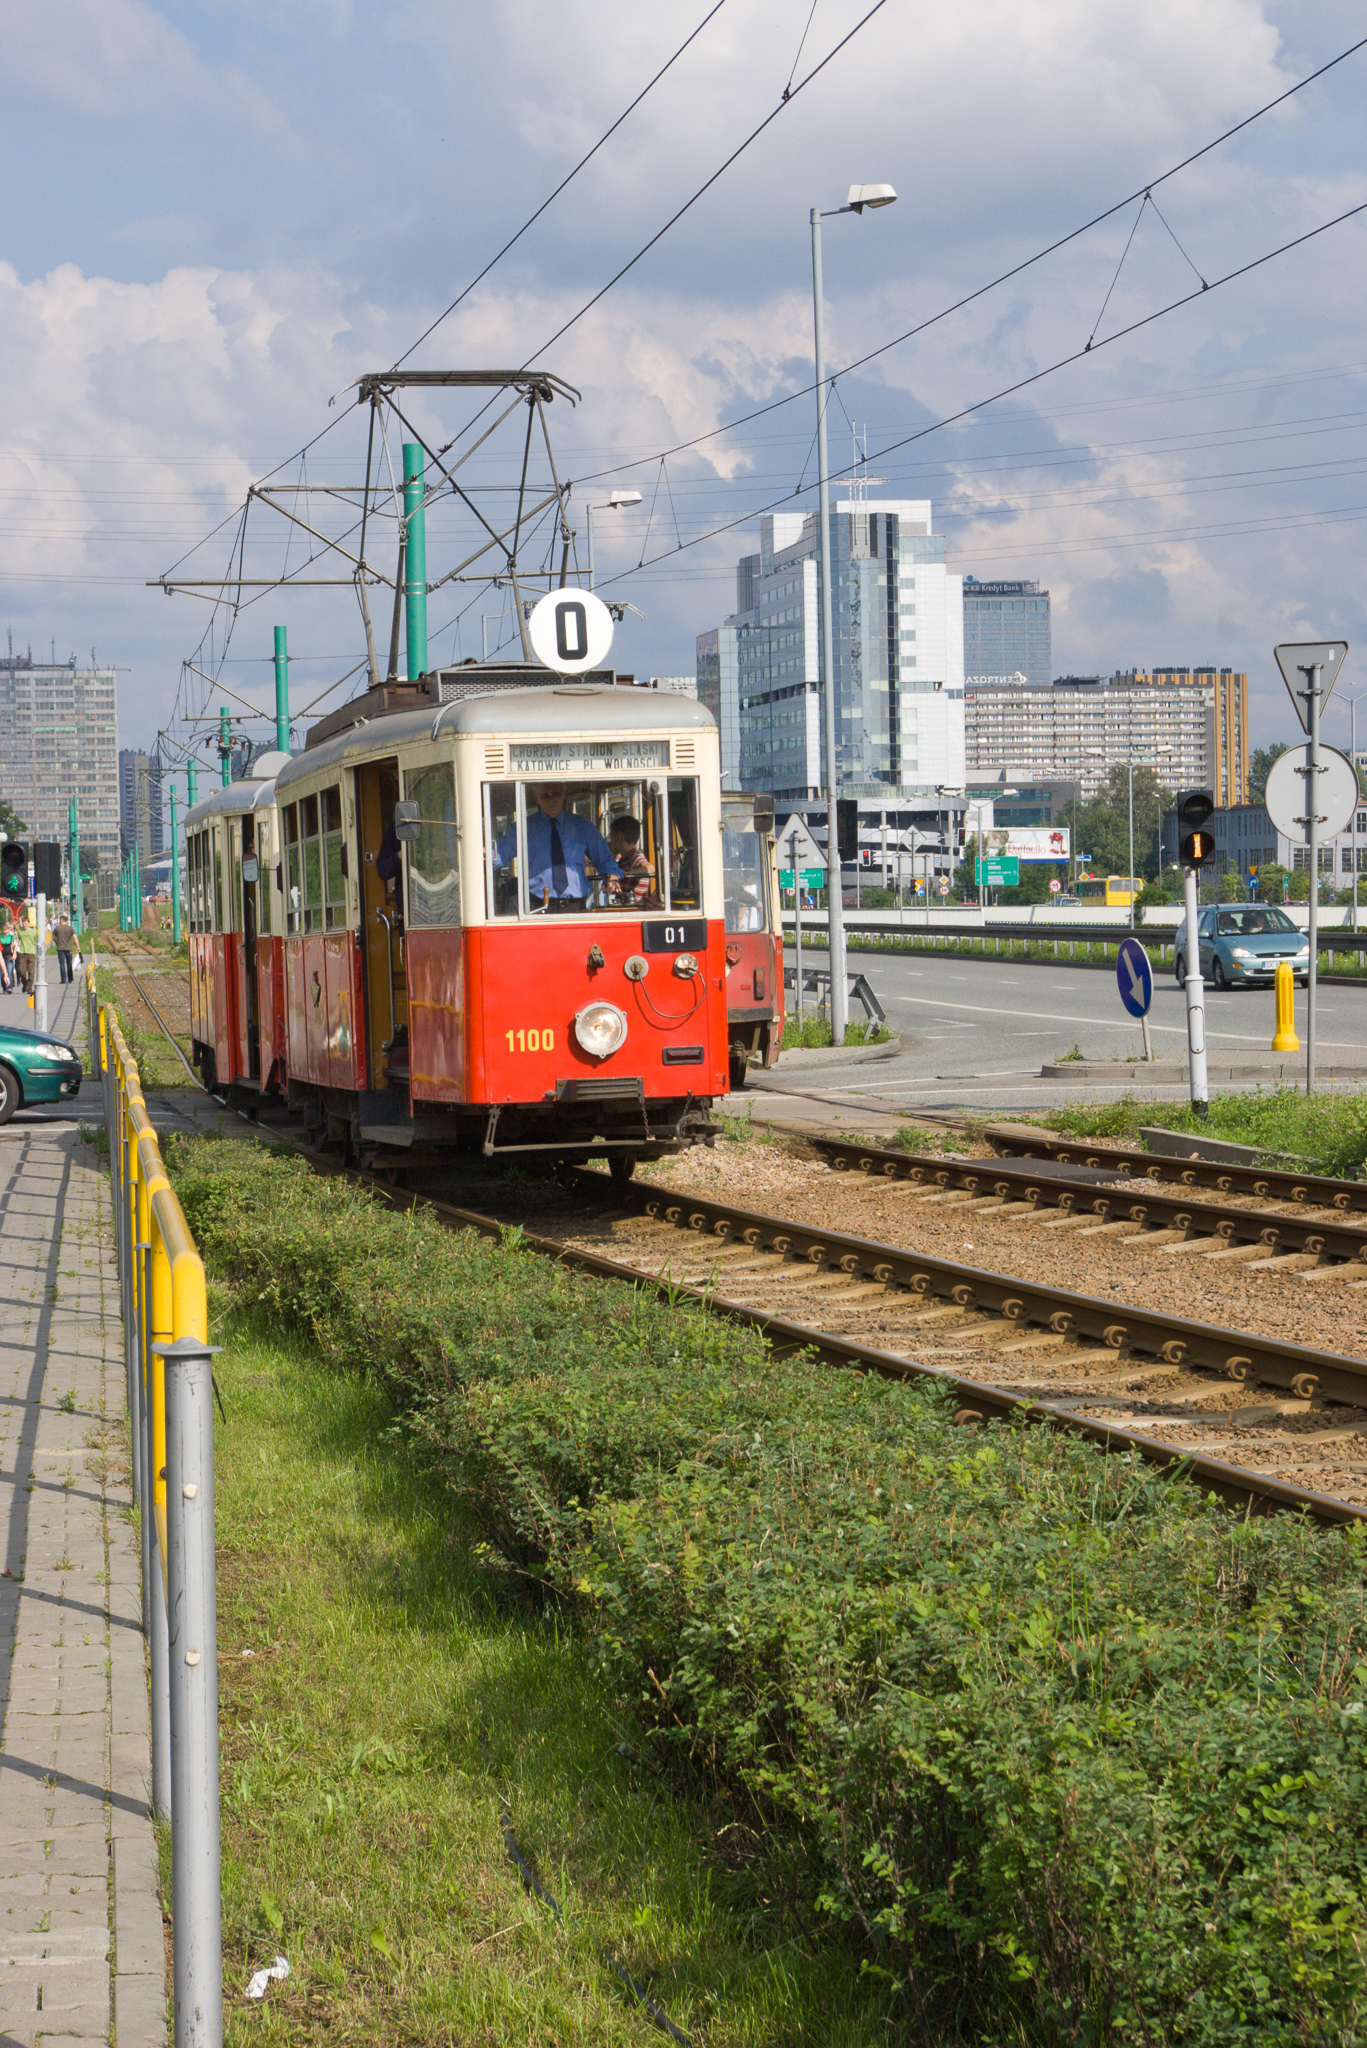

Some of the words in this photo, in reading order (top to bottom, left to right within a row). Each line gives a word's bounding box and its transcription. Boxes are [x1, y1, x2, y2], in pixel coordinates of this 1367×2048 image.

[981, 584, 1003, 593] Kredyt
[1003, 584, 1020, 592] Bank
[569, 743, 613, 757] STADION
[517, 759, 571, 772] KATOWICE
[1007, 844, 1047, 855] Raffaello
[665, 926, 685, 944] 01
[505, 1028, 555, 1052] 1100
